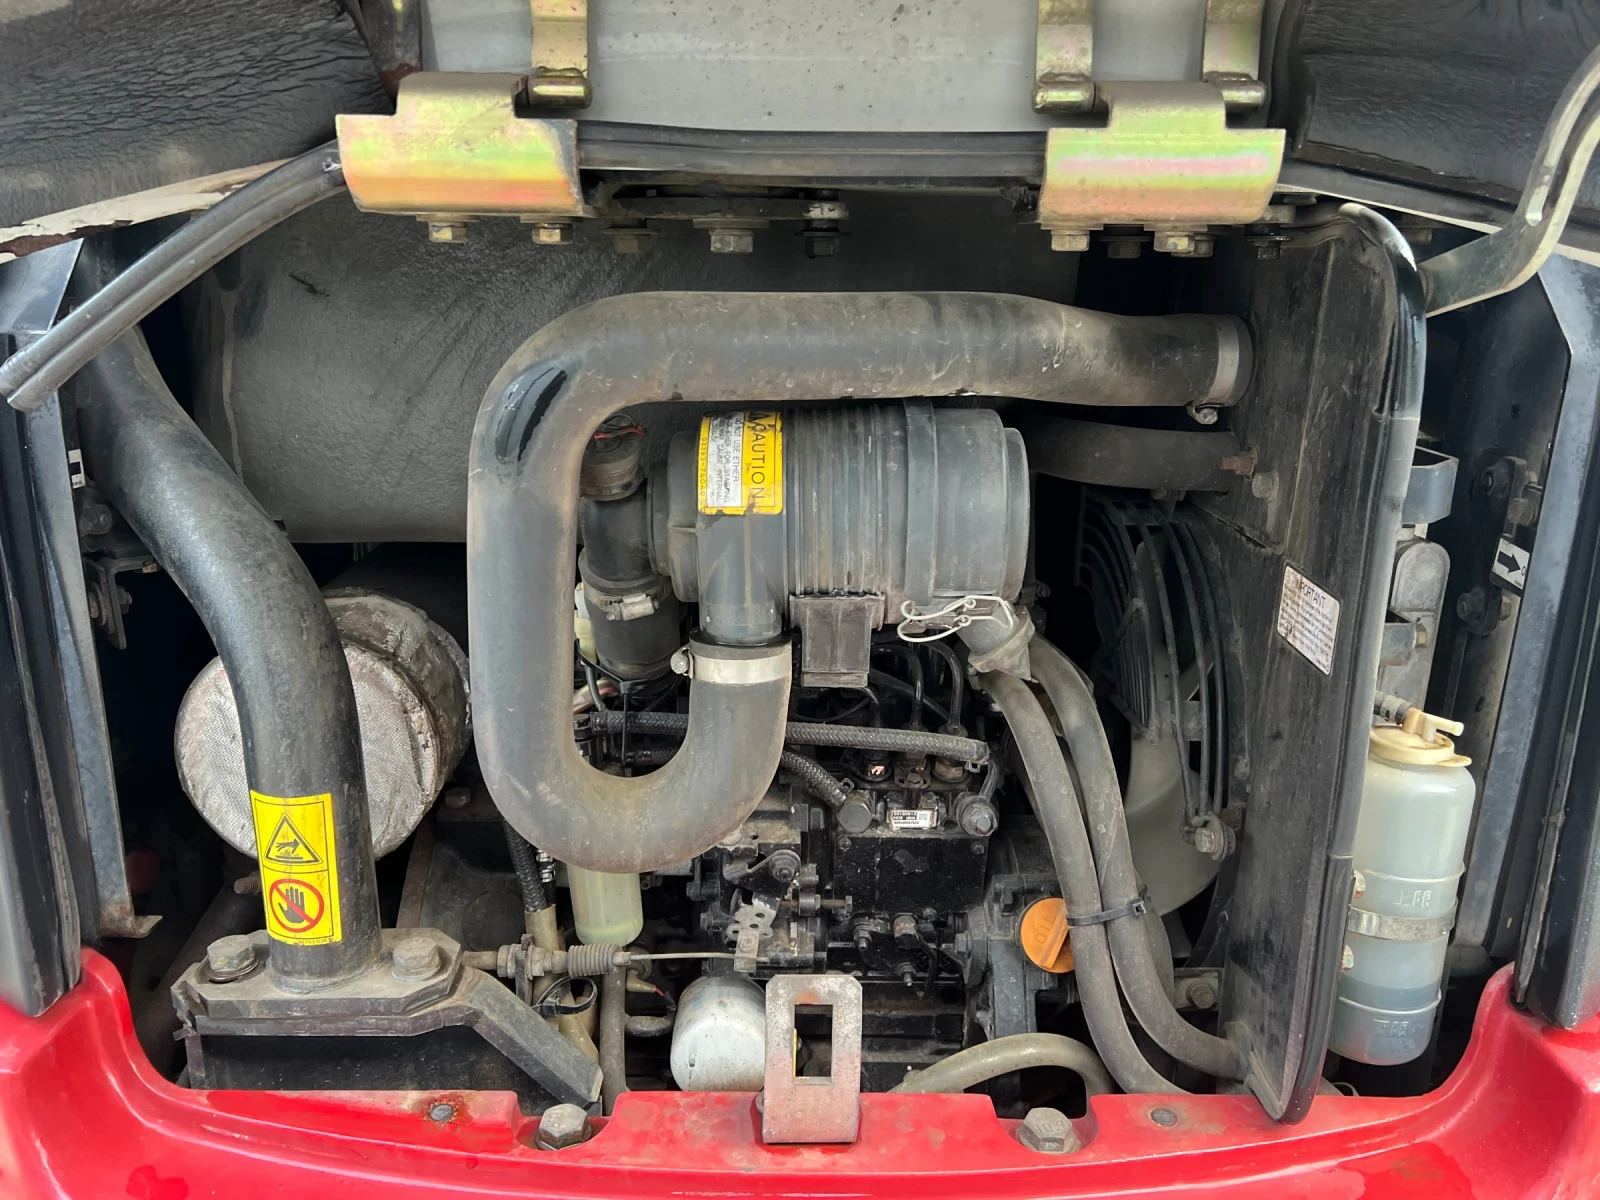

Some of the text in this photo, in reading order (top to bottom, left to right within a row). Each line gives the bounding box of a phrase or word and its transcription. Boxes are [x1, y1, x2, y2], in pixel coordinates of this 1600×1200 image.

[732, 439, 741, 454] USE
[732, 456, 740, 482] ETHER
[751, 424, 767, 499] CAUTION
[1035, 916, 1057, 944] OIL
